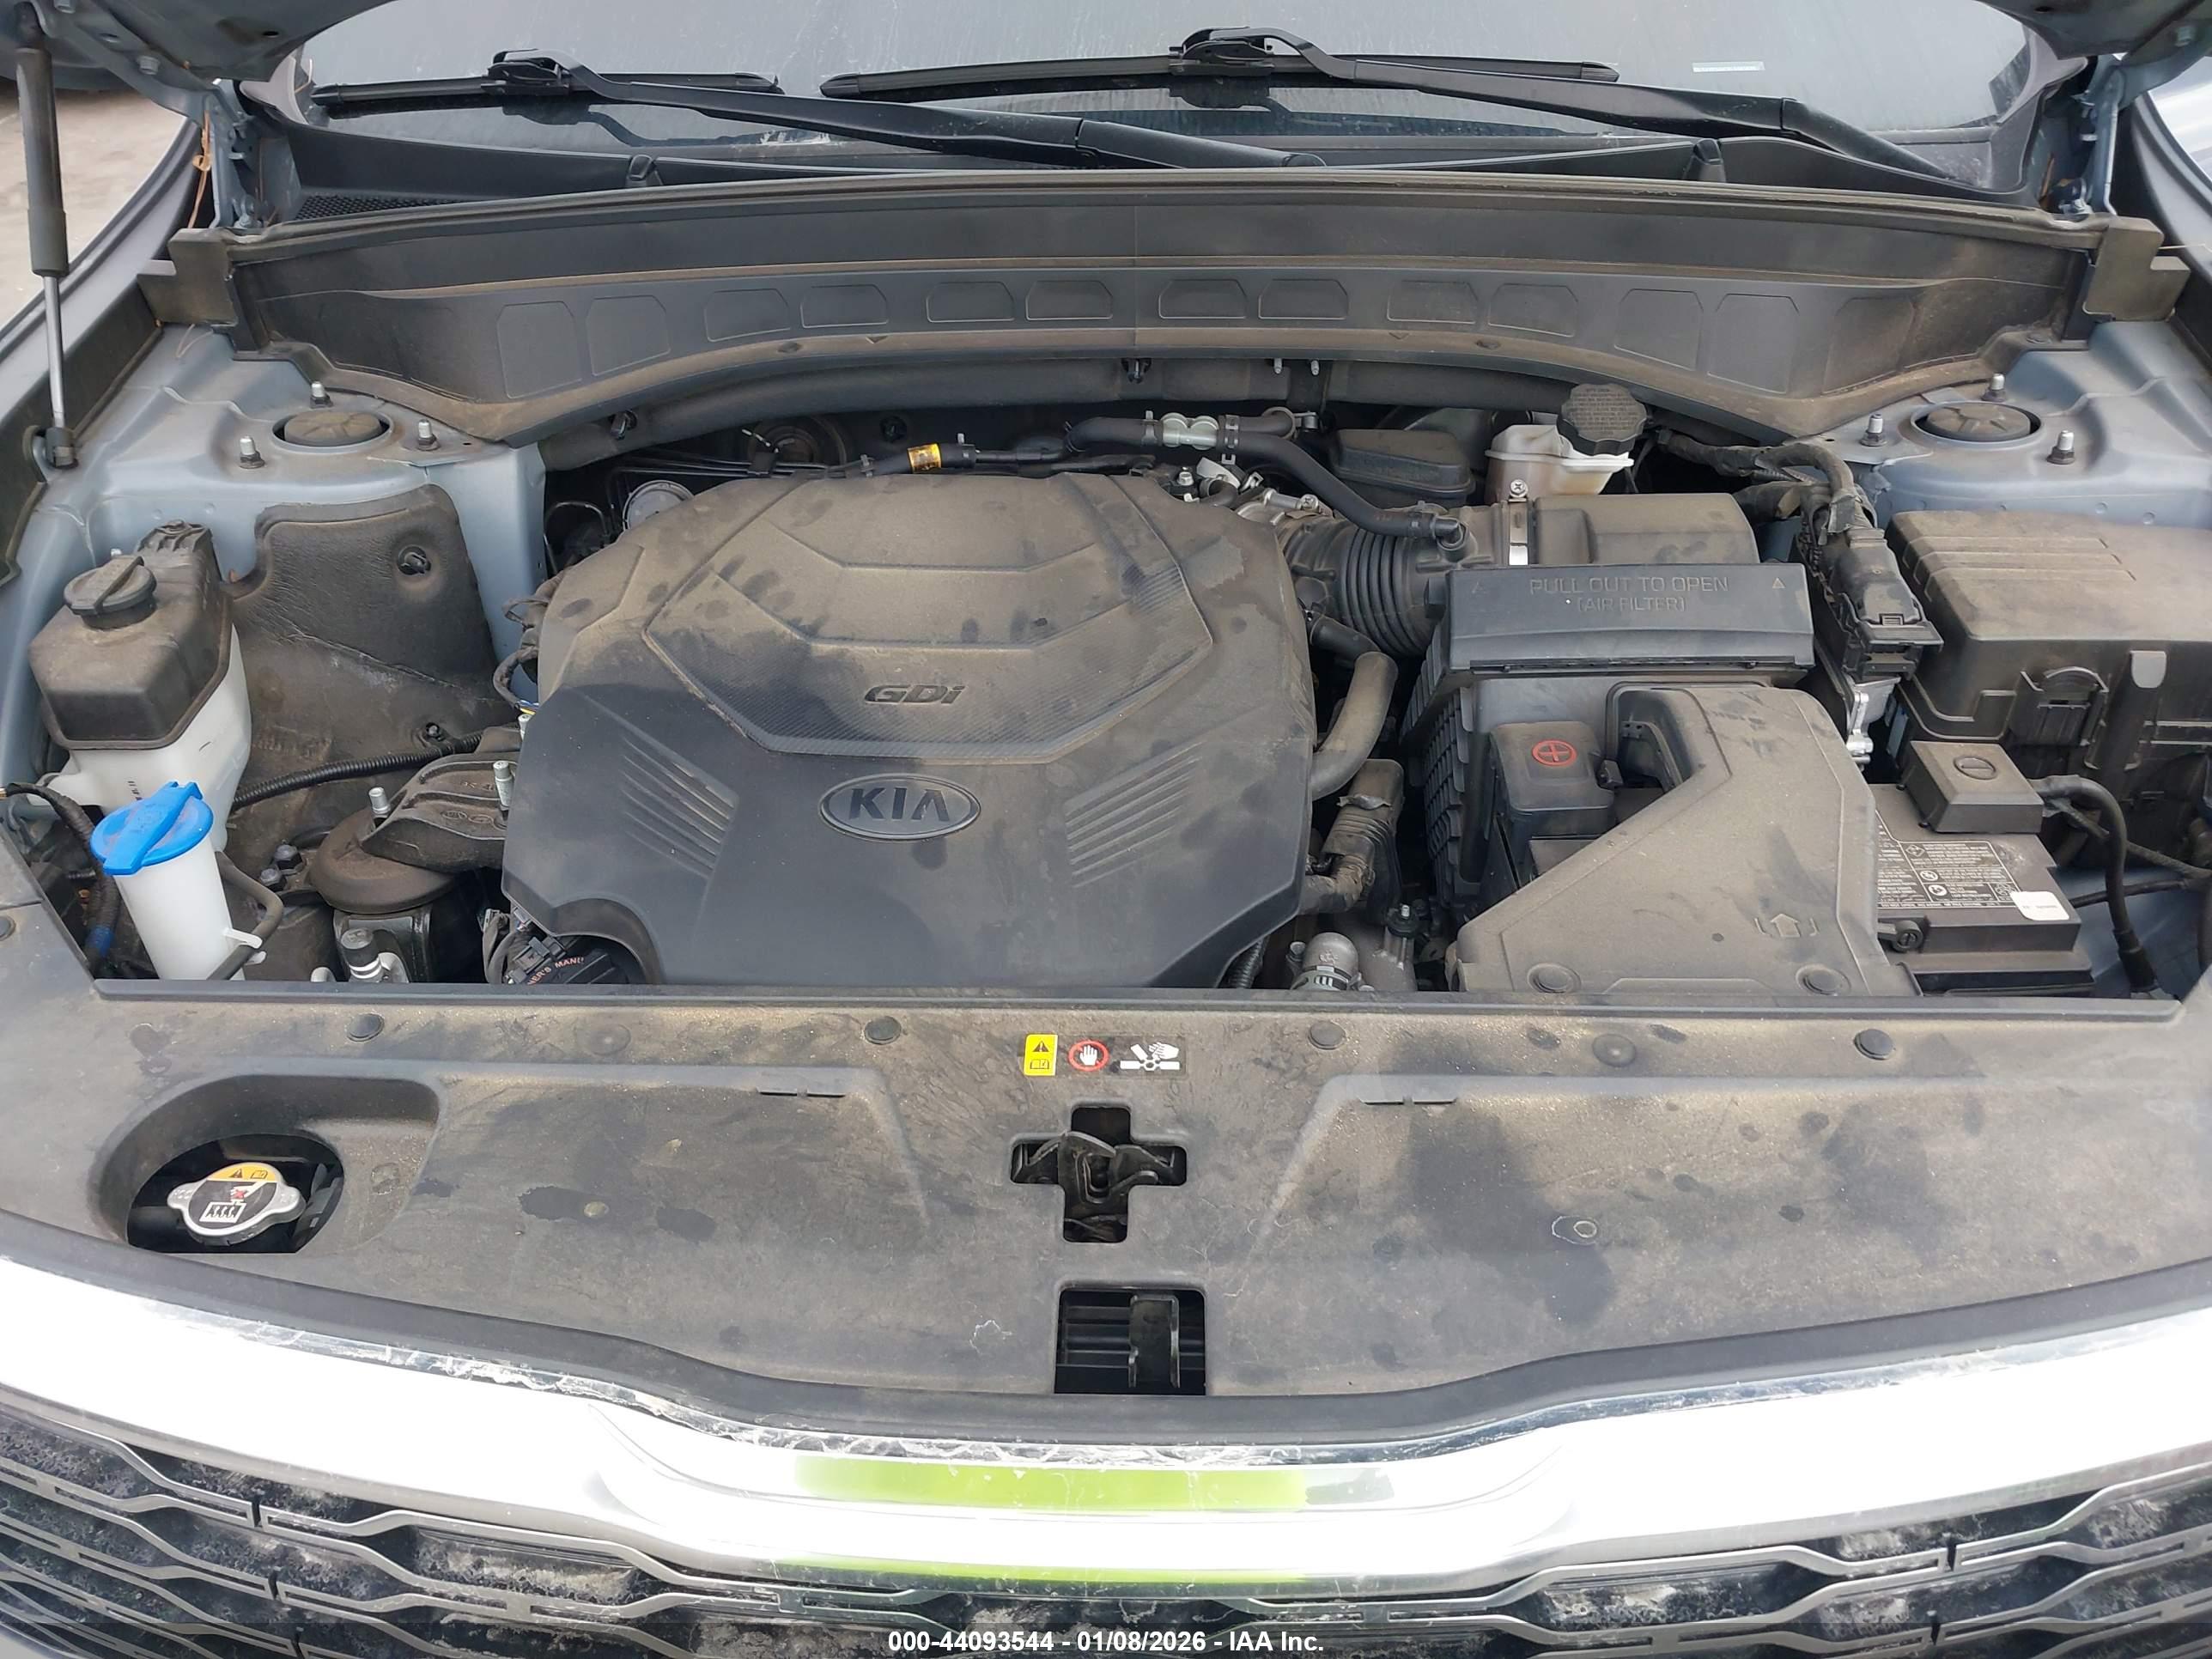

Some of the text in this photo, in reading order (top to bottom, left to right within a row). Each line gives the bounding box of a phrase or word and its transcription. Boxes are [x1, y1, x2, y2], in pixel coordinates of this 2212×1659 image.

[1529, 576, 1729, 595] PULL OUT TO OPEN
[865, 684, 968, 705] GDi
[849, 787, 950, 822] KIA
